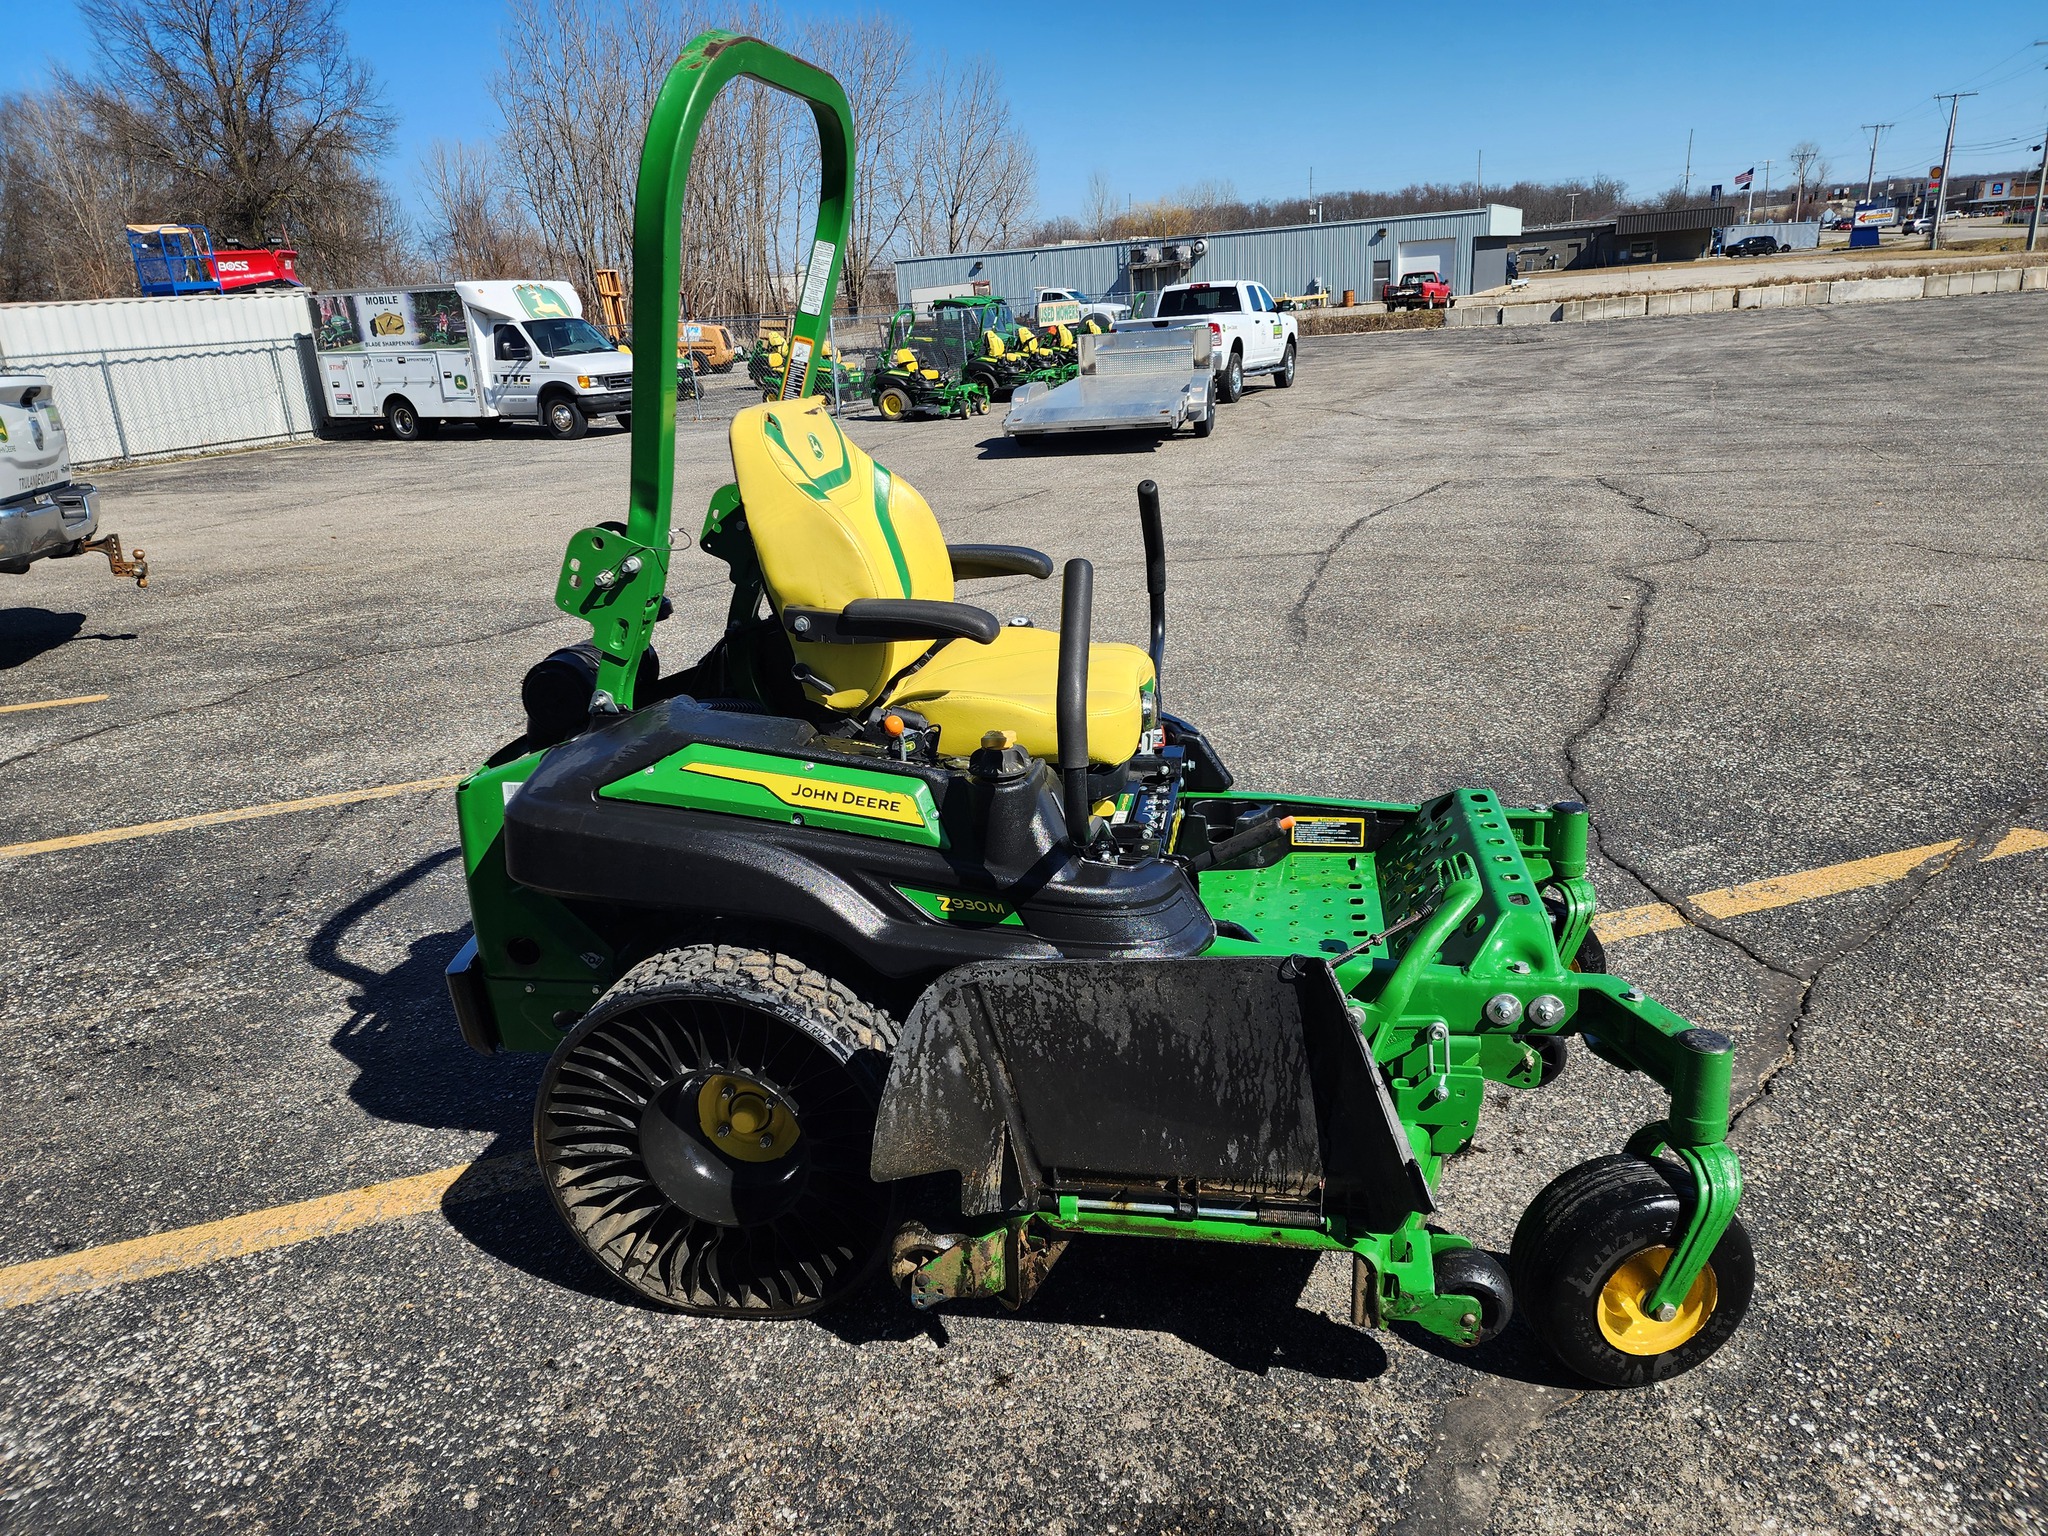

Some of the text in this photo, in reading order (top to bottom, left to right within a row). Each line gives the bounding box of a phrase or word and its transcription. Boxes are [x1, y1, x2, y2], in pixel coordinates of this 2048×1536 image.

[217, 261, 249, 272] BOSS
[365, 295, 399, 306] MOBILE
[1040, 304, 1079, 323] USED MOWERS
[382, 340, 415, 348] SHARPENING
[500, 374, 531, 385] TTG
[791, 783, 901, 813] JOHN DEERE
[936, 895, 1006, 915] Z930M
